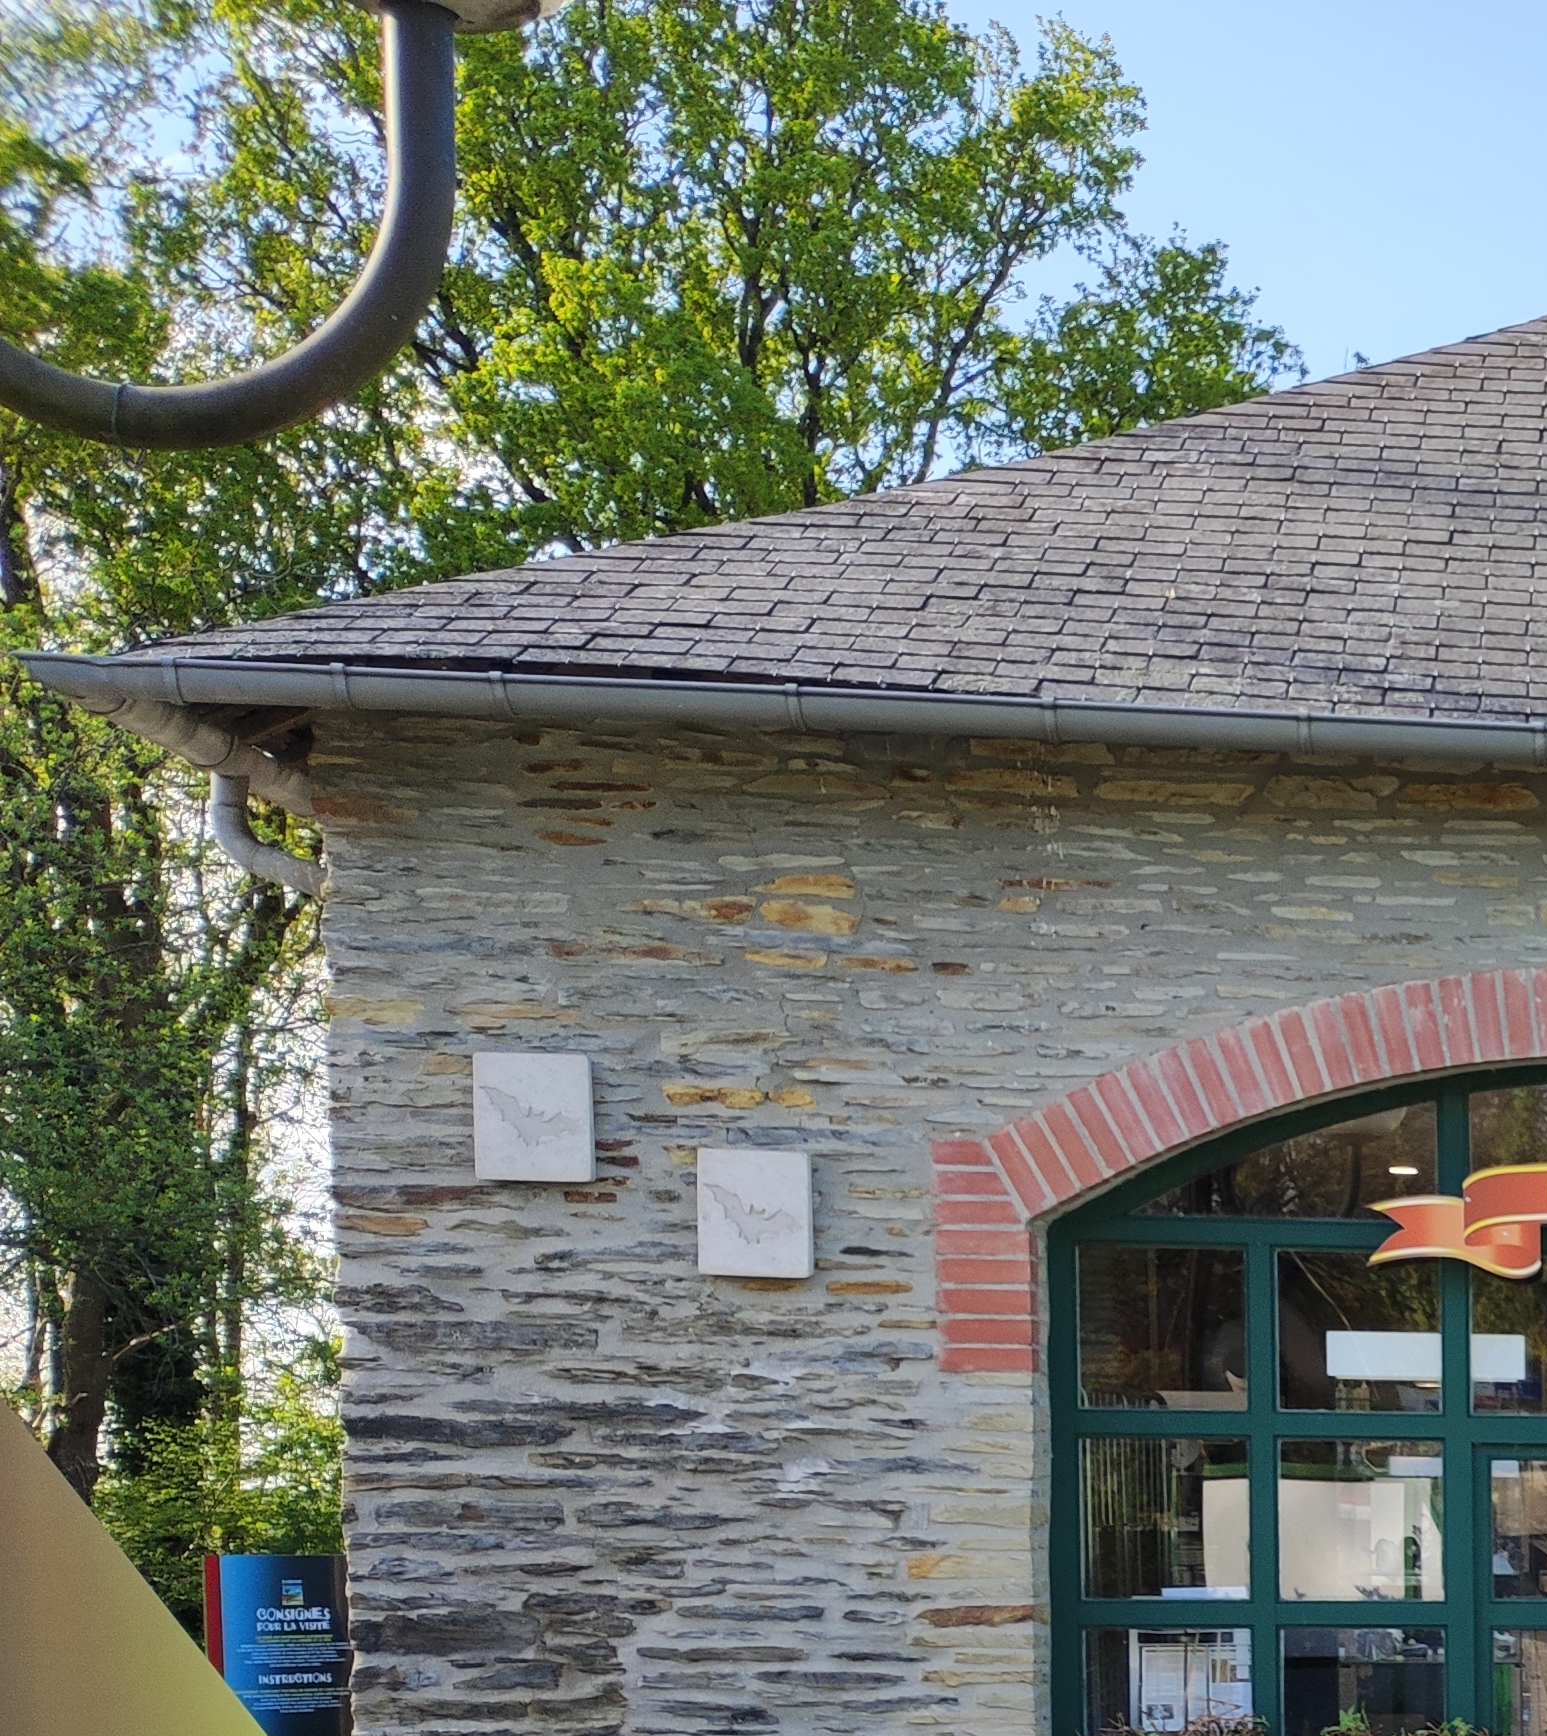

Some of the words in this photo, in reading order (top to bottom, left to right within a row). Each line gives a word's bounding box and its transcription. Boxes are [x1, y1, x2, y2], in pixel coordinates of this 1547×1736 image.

[256, 1607, 331, 1621] CONSIGNES
[256, 1621, 281, 1632] POUR
[283, 1621, 297, 1631] LA
[299, 1620, 331, 1631] VISITE
[258, 1672, 333, 1685] INSTRUCTIONS
